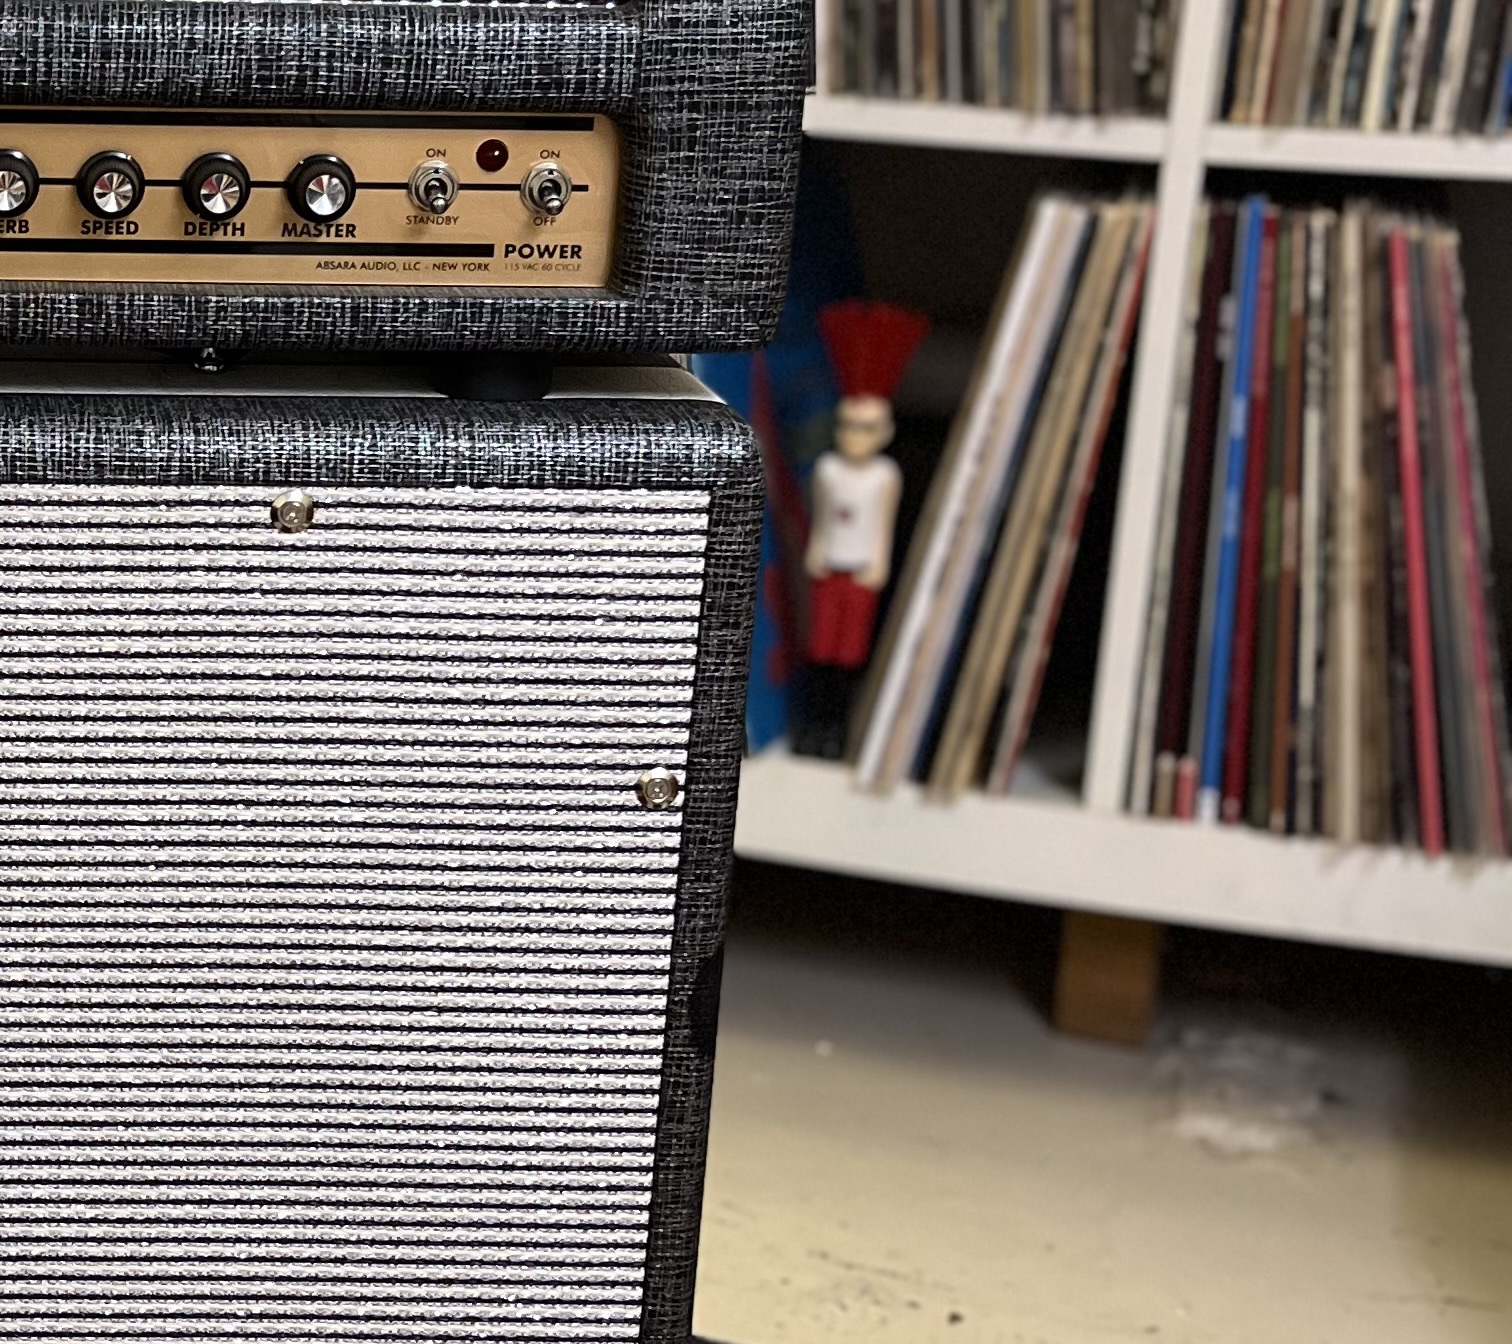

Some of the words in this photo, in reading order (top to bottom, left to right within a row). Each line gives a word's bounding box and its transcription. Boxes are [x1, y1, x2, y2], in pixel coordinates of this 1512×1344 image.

[425, 147, 447, 158] ON
[539, 149, 561, 160] ON
[405, 215, 460, 226] STANDBY
[532, 216, 557, 227] OFF
[80, 220, 140, 236] SPEED
[183, 221, 246, 237] DEPTH
[281, 222, 357, 238] MASTER
[503, 243, 583, 260] POWER
[315, 260, 357, 271] ABSARA
[359, 261, 400, 273] AUDIO,
[402, 261, 422, 272] LLC
[432, 261, 459, 272] NEW
[461, 262, 491, 273] YORK
[503, 262, 520, 272] 115
[522, 262, 539, 272] VAC
[541, 262, 553, 272] 60
[554, 262, 582, 272] CYCLE
